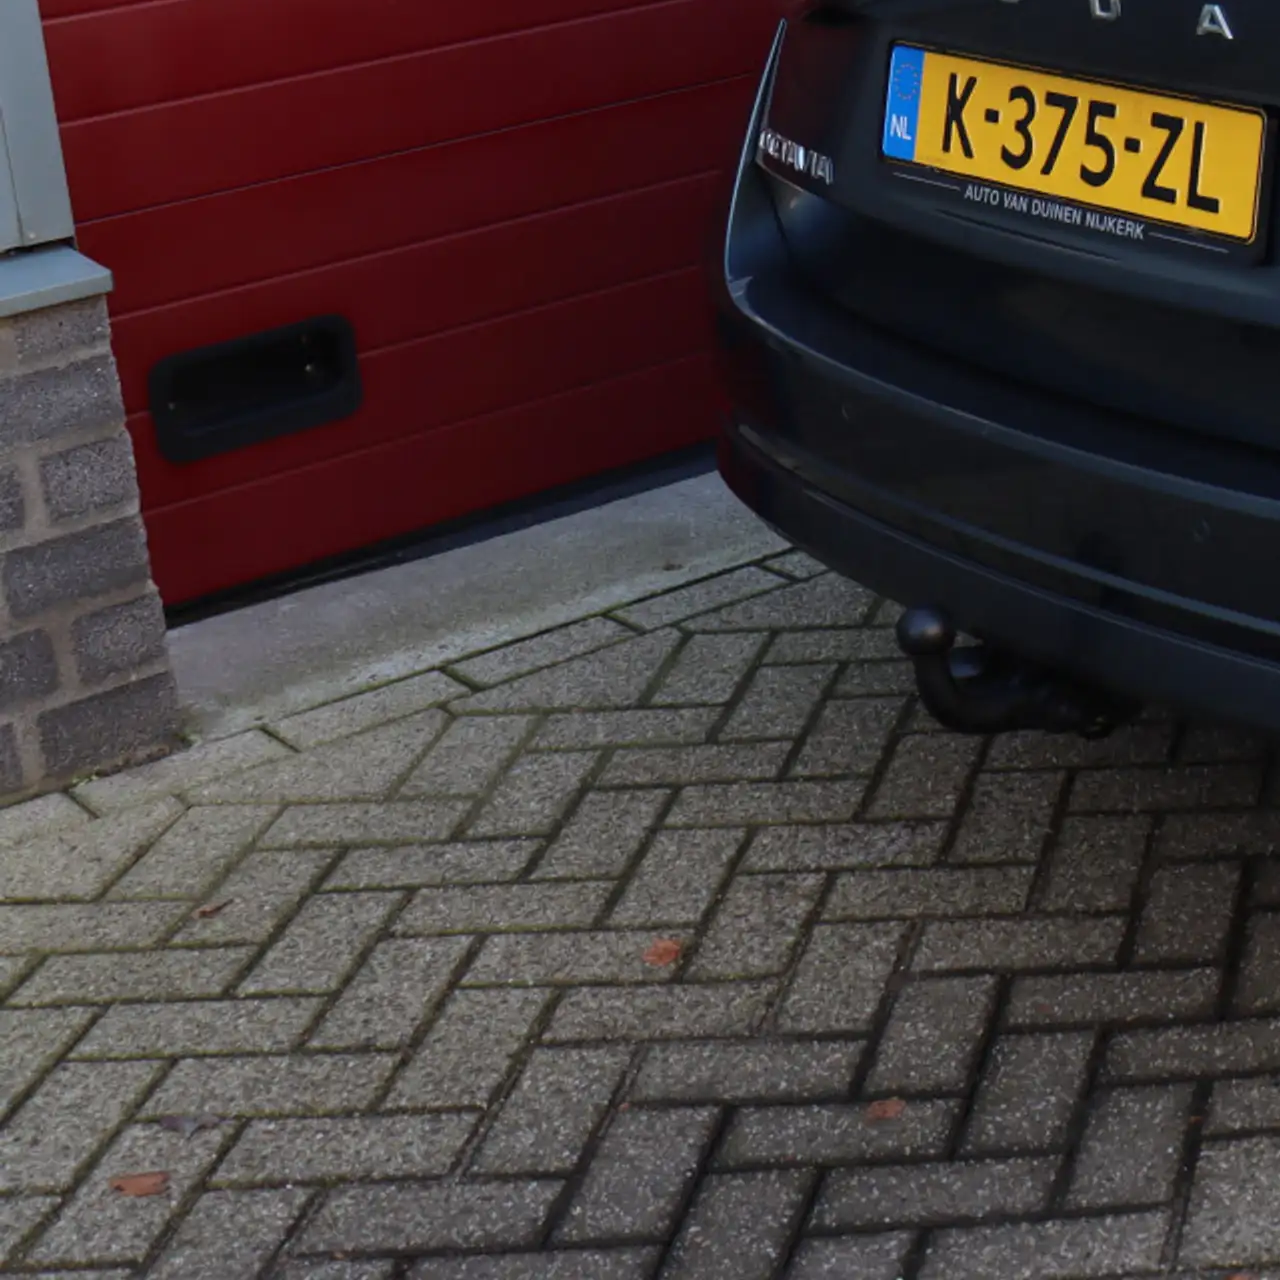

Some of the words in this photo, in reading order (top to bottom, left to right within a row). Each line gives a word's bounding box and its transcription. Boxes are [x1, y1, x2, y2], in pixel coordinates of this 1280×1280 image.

[889, 114, 913, 142] NL
[941, 72, 1221, 214] K-375-ZL
[964, 183, 1000, 206] AUTO
[1003, 192, 1028, 212] VAN
[1031, 199, 1082, 225] DUINEN
[1085, 211, 1145, 240] NIJKERK
